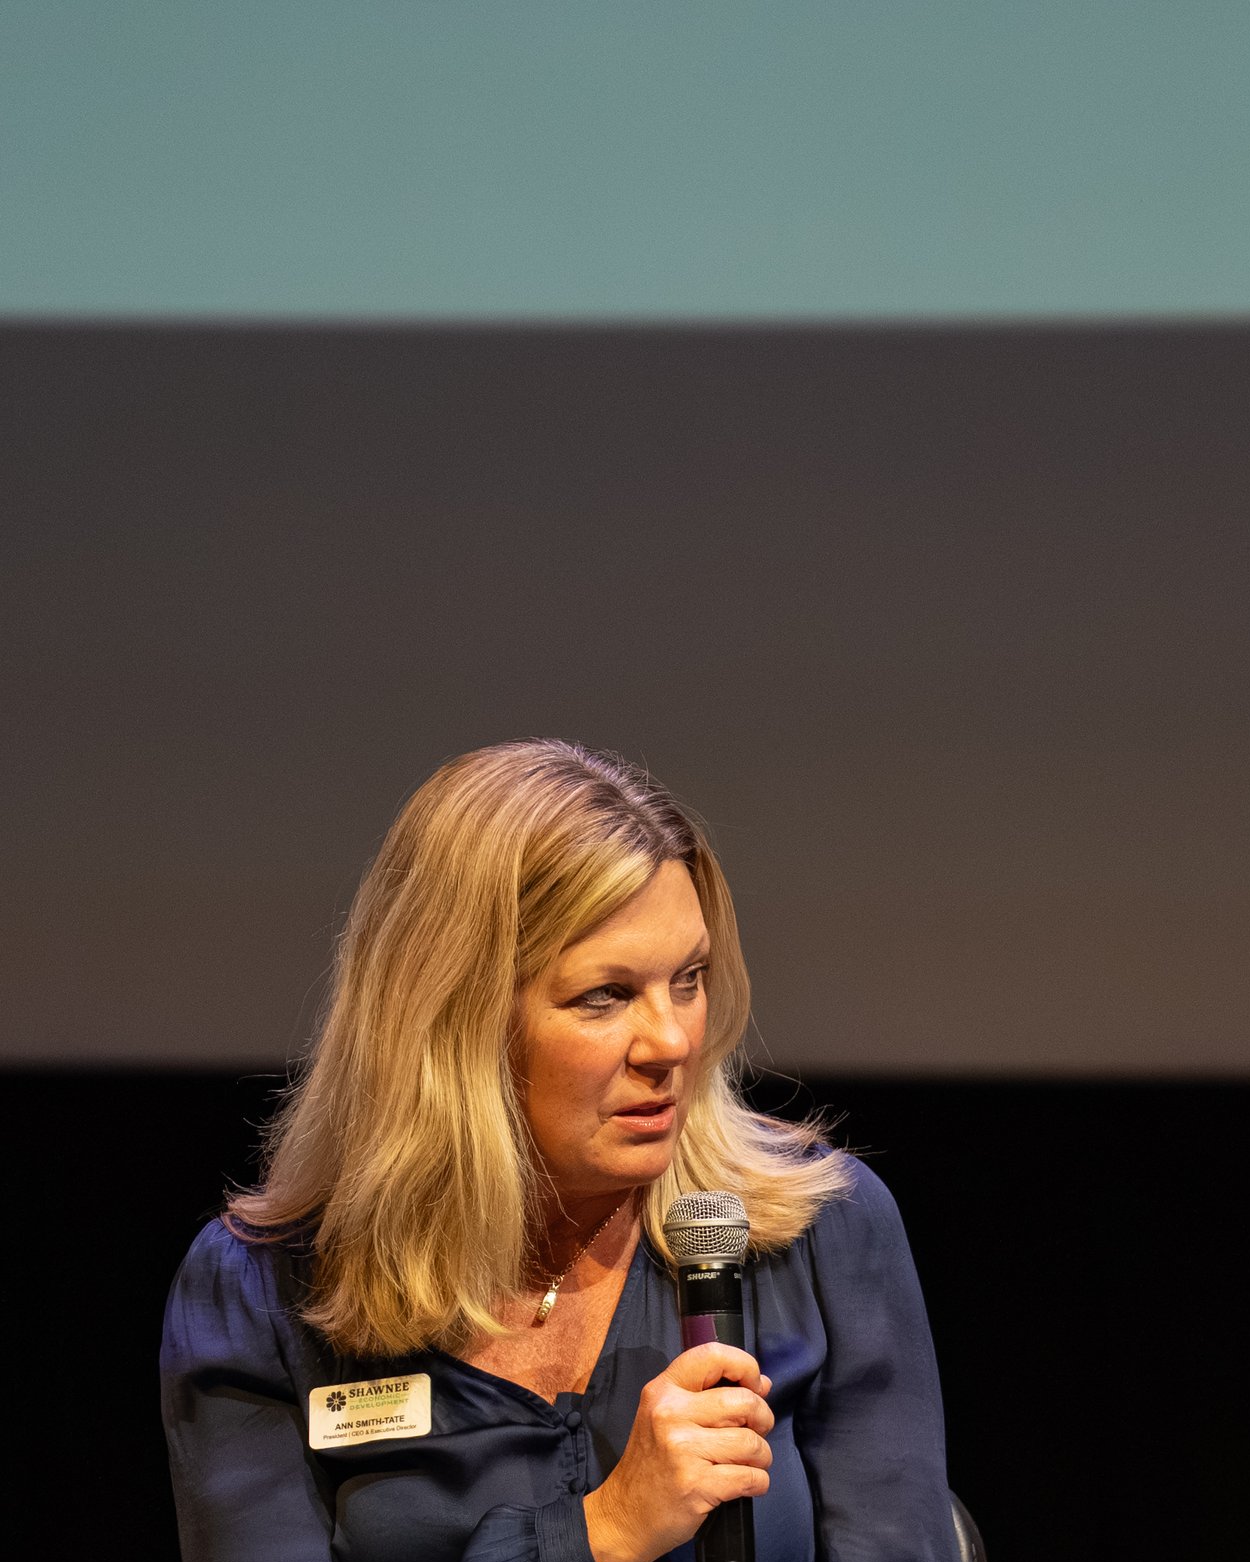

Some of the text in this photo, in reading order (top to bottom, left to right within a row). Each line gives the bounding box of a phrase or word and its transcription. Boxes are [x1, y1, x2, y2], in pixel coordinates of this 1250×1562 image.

[349, 1382, 410, 1399] SHAWNEE
[358, 1393, 401, 1403] ECONOMIC
[349, 1399, 409, 1411] DEVELOPMENT
[335, 1415, 405, 1431] ANN SMITH-TATE
[370, 1427, 395, 1435] Executive
[396, 1424, 416, 1432] Director
